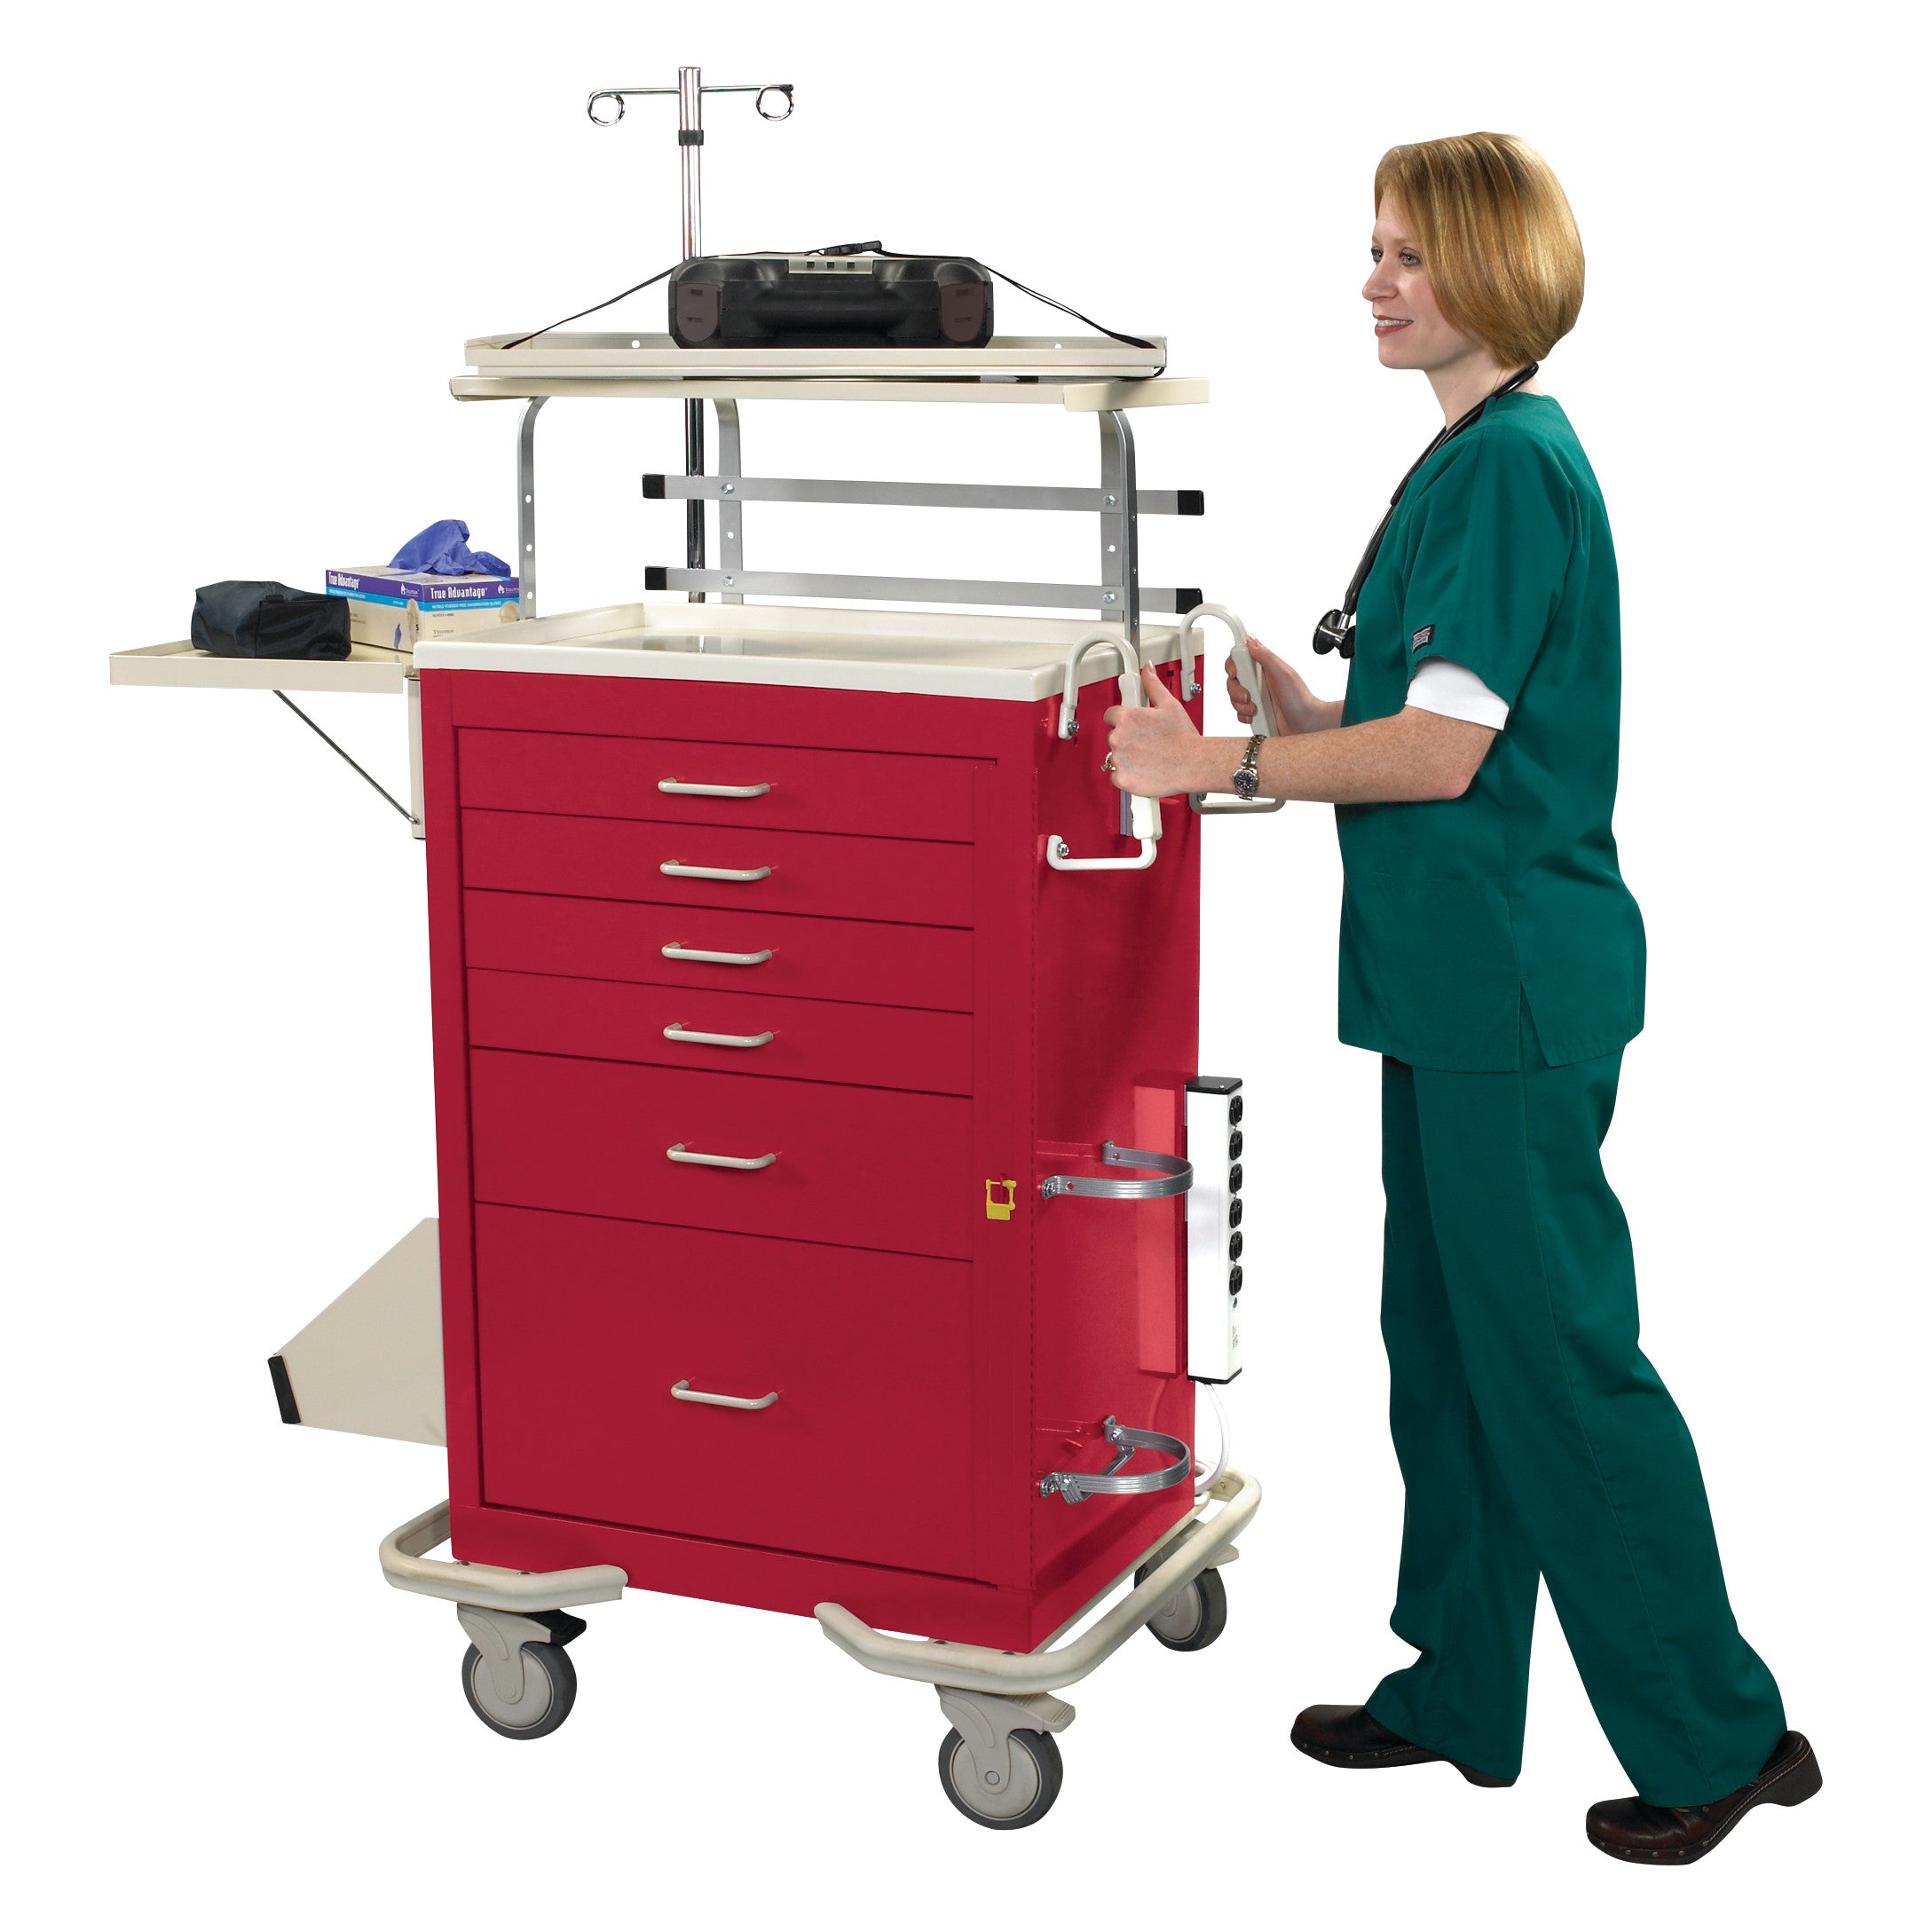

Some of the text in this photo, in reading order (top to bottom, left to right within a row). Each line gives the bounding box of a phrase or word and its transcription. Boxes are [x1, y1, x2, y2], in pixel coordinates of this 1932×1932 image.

[328, 572, 337, 586] True
[430, 587, 446, 599] True
[447, 586, 486, 599] Advantage
